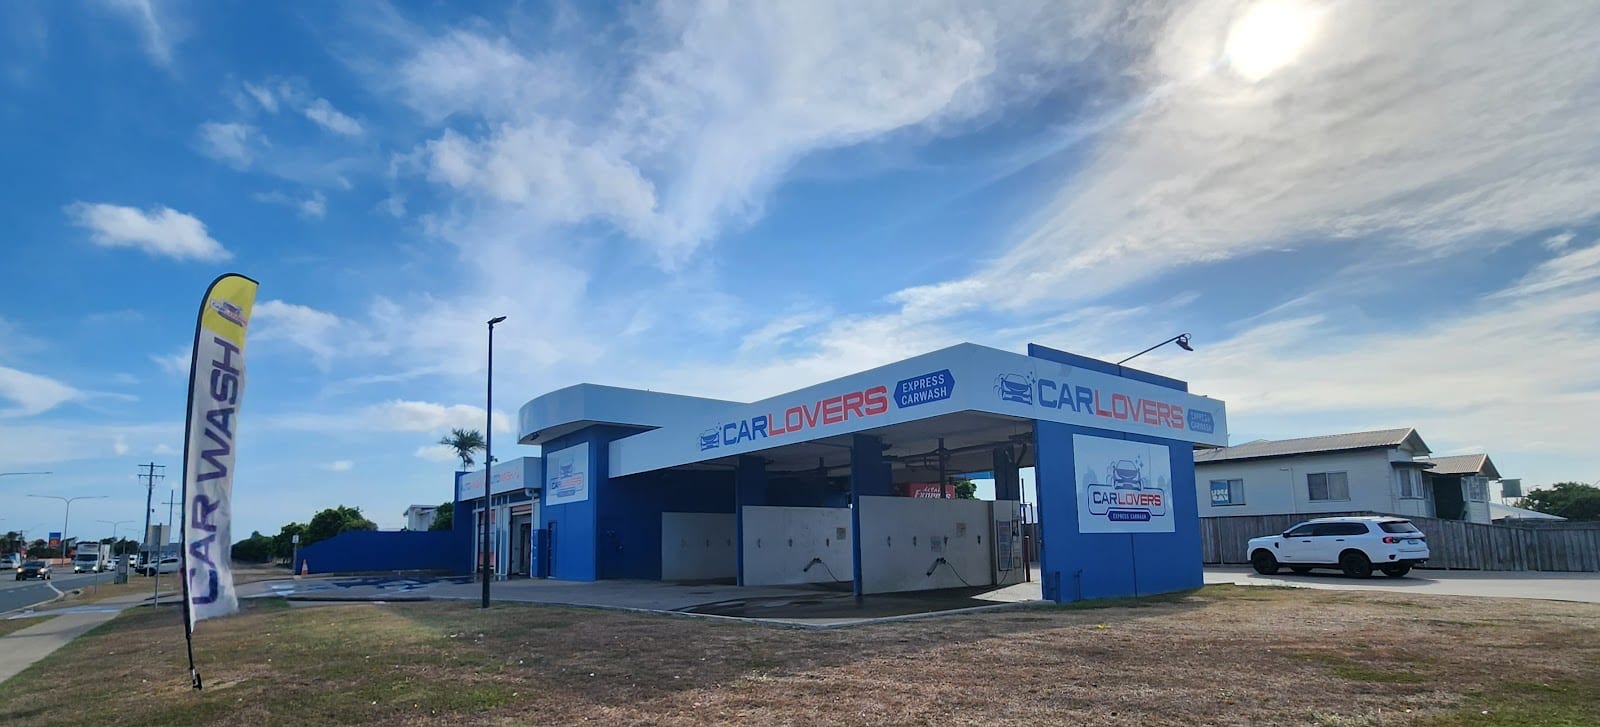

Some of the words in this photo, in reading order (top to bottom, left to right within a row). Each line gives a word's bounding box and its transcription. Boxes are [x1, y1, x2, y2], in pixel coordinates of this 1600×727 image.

[197, 336, 241, 482] WASH
[901, 386, 947, 405] CARWASH
[902, 374, 945, 393] EXPRESS
[1037, 378, 1184, 429] CARLOVERS
[722, 385, 889, 445] CARLOVERS
[1092, 491, 1162, 506] CARLOVERS
[188, 494, 220, 605] CAR
